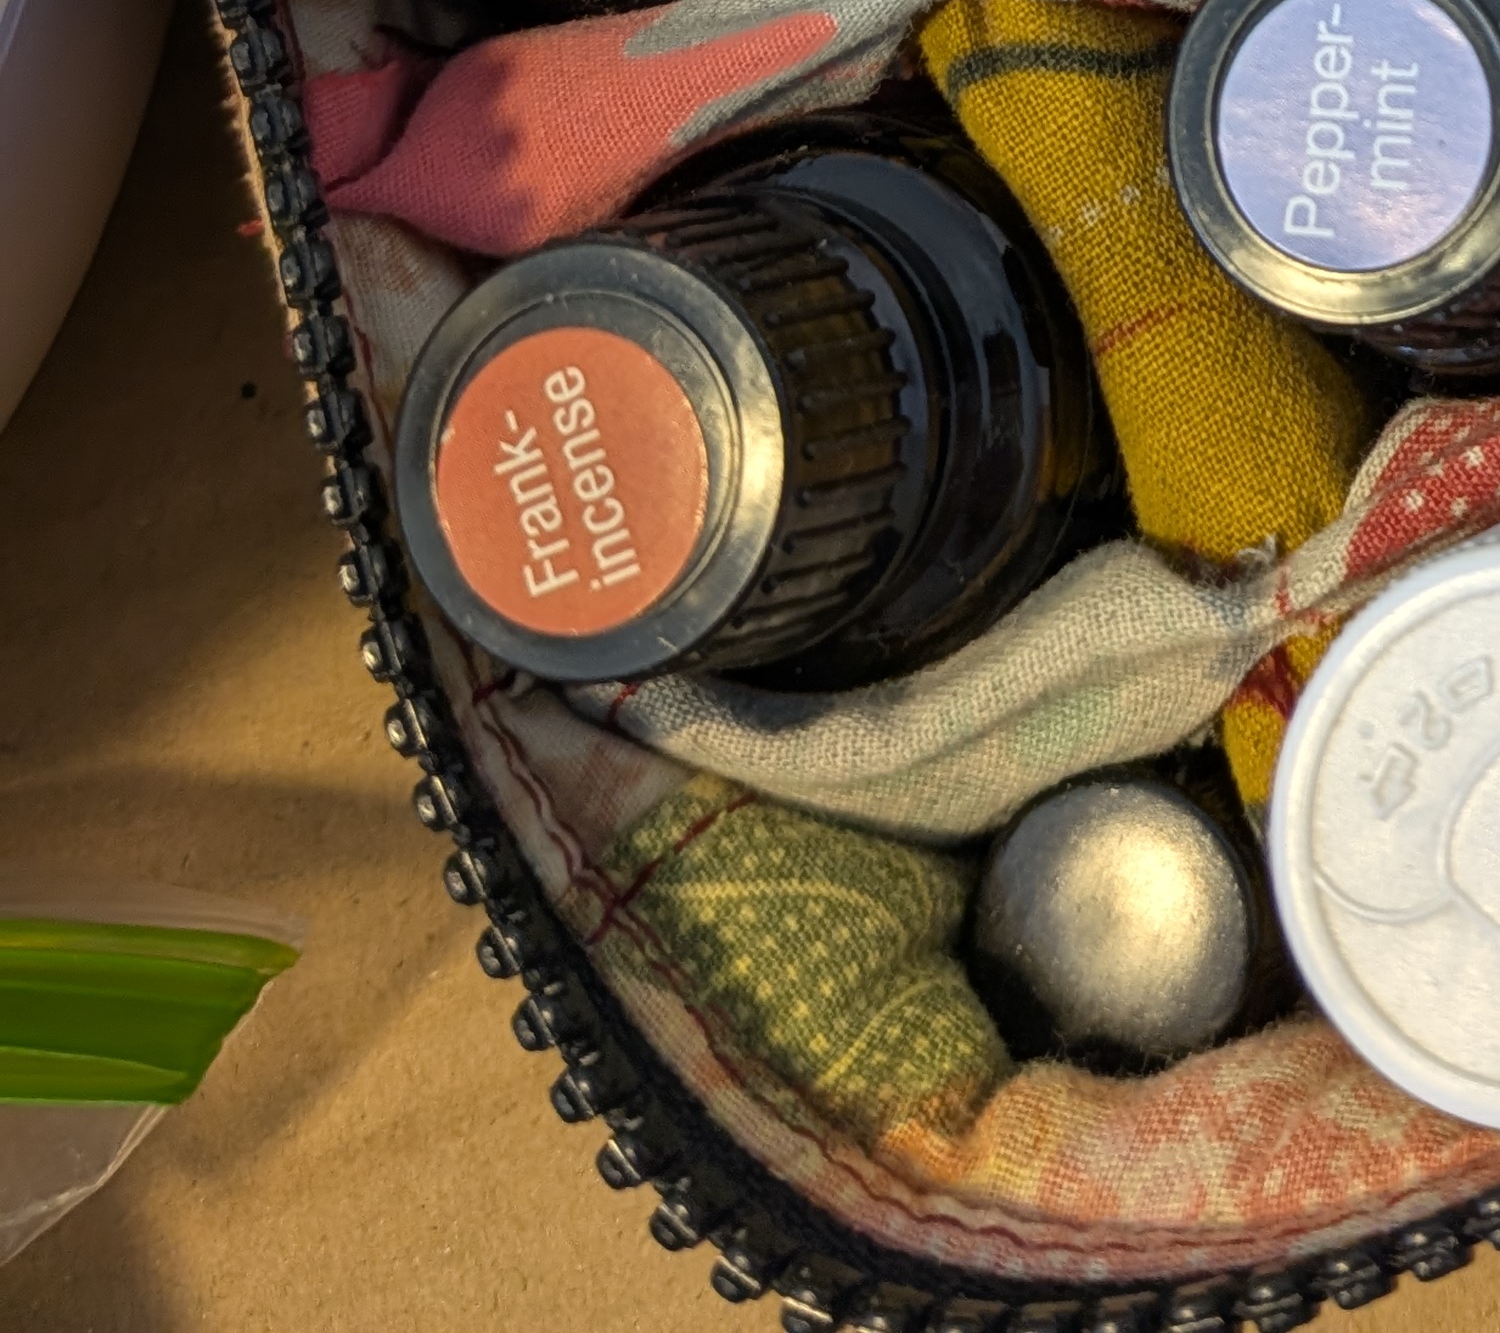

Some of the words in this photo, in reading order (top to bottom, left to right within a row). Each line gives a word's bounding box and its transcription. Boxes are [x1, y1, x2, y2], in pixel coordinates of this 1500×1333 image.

[1283, 3, 1360, 238] Pepper-
[1363, 59, 1419, 191] mint
[494, 410, 579, 598] Frank-
[544, 366, 641, 592] incense
